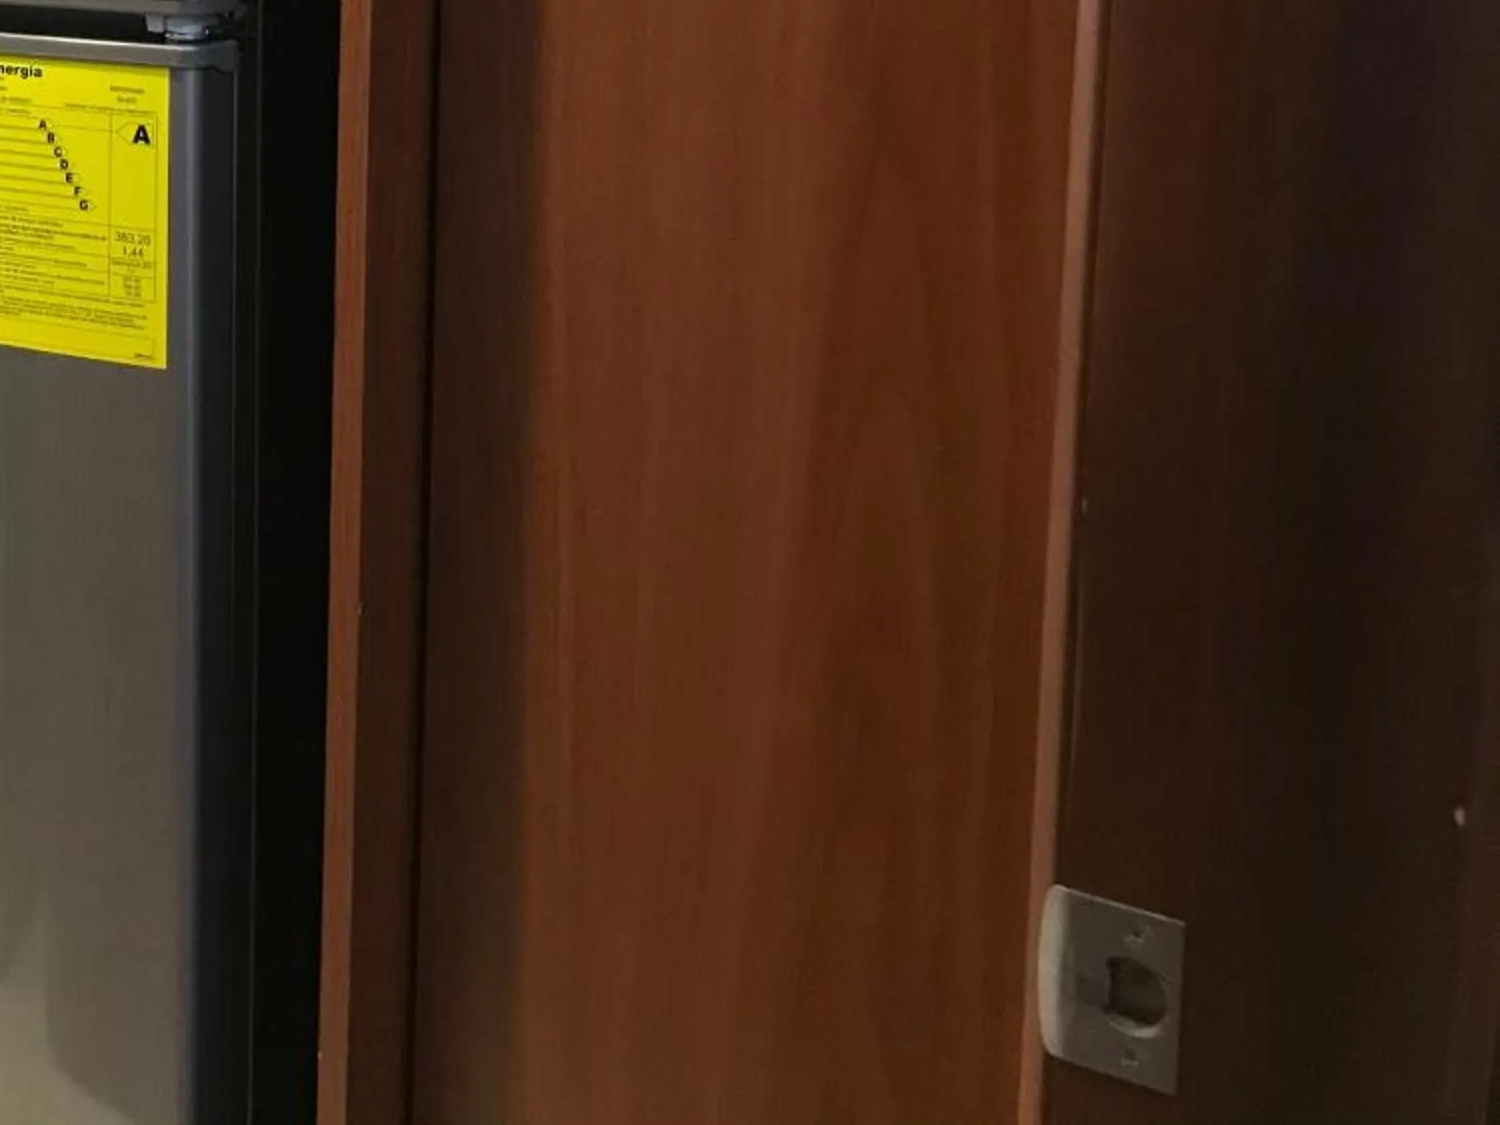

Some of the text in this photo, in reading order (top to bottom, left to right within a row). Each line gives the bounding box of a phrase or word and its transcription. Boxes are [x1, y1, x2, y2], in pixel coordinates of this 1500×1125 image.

[38, 120, 47, 131] A
[132, 124, 151, 145] A
[65, 172, 74, 183] E
[73, 186, 81, 196] F
[79, 200, 88, 211] G
